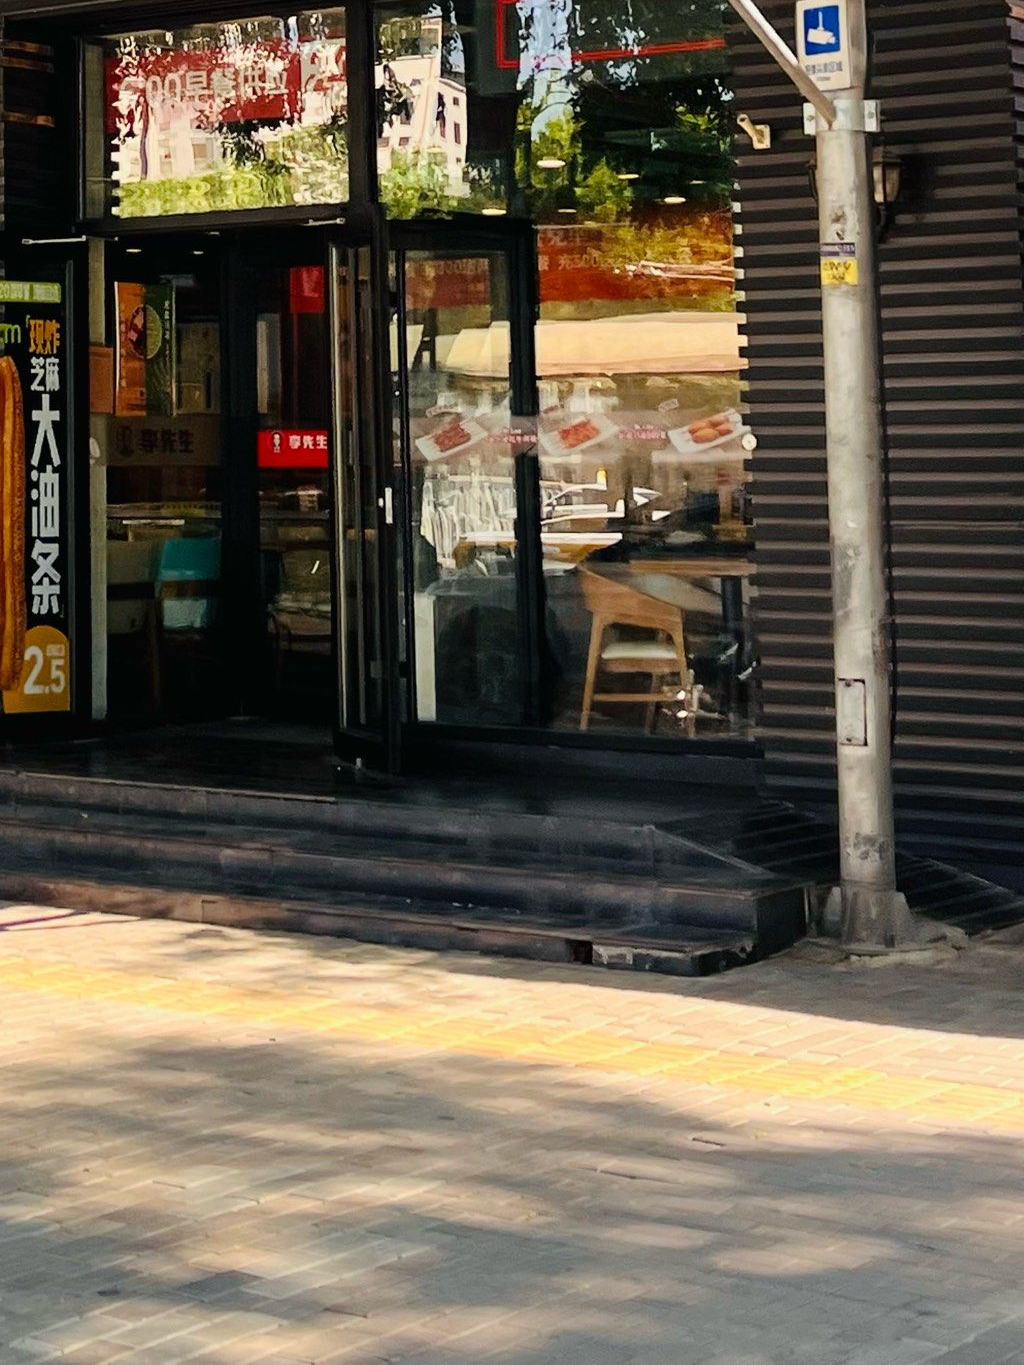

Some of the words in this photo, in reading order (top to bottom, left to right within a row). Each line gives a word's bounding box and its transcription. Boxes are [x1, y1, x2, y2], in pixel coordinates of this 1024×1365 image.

[289, 434, 328, 450] 李先生
[31, 393, 62, 615] 大油条
[23, 645, 66, 695] 2.5
